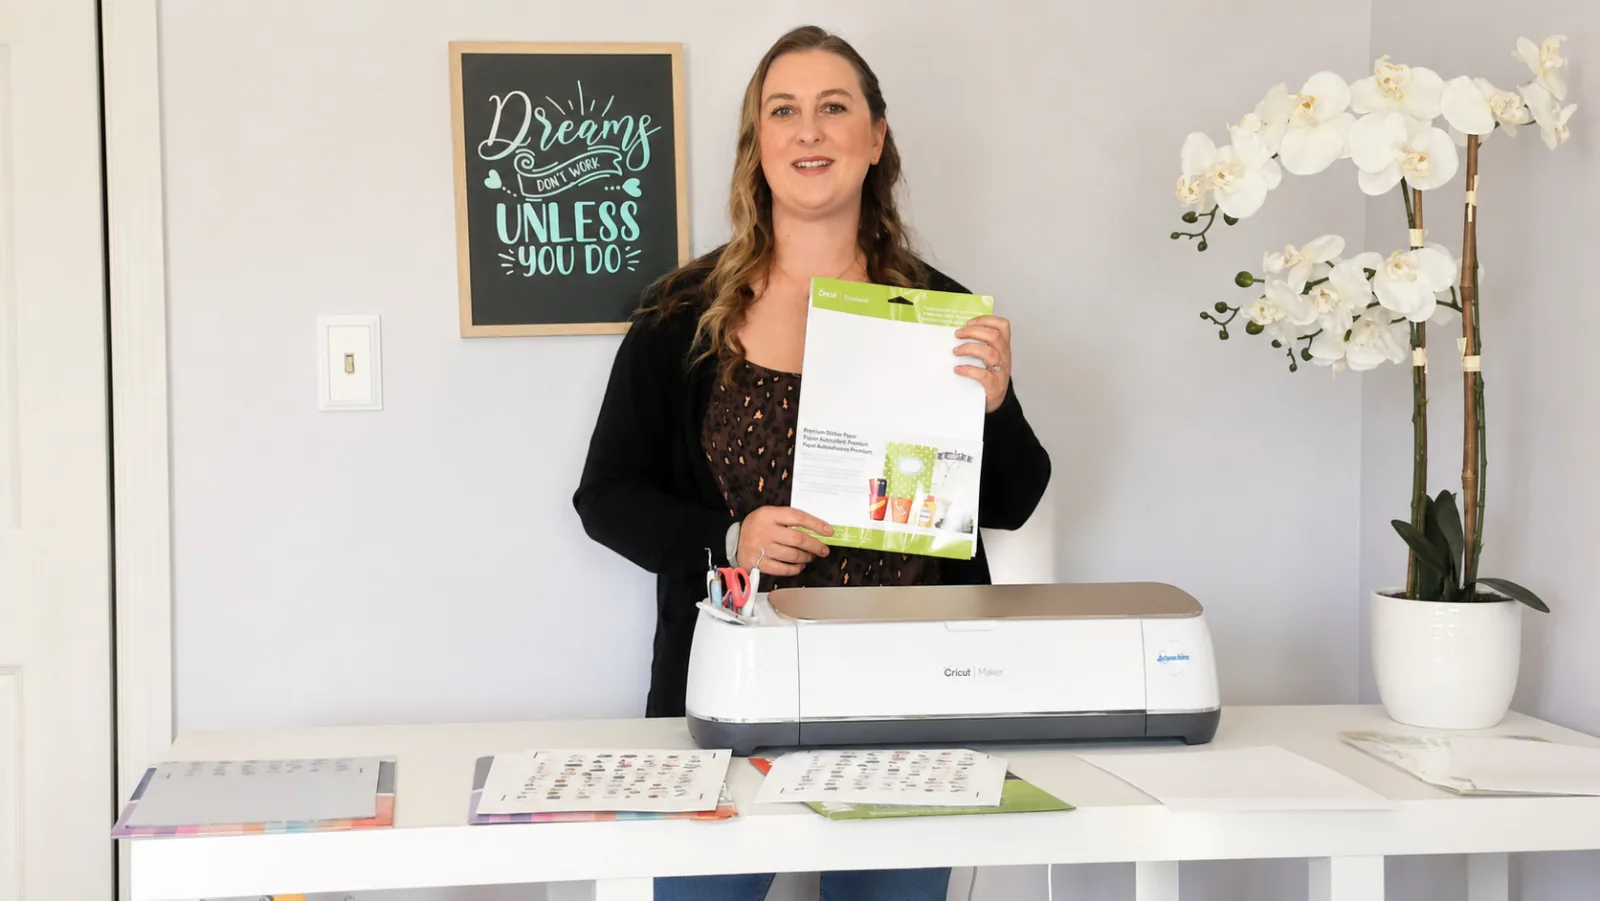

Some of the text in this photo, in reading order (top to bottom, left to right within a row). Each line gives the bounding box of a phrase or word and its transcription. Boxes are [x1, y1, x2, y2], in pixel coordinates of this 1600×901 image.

[478, 90, 662, 172] Dreams
[536, 157, 600, 192] DON'T WORK
[496, 200, 641, 244] UNLESS
[518, 244, 621, 277] YOU DO
[803, 427, 826, 435] Premium
[943, 665, 1004, 678] Cricut Maker
